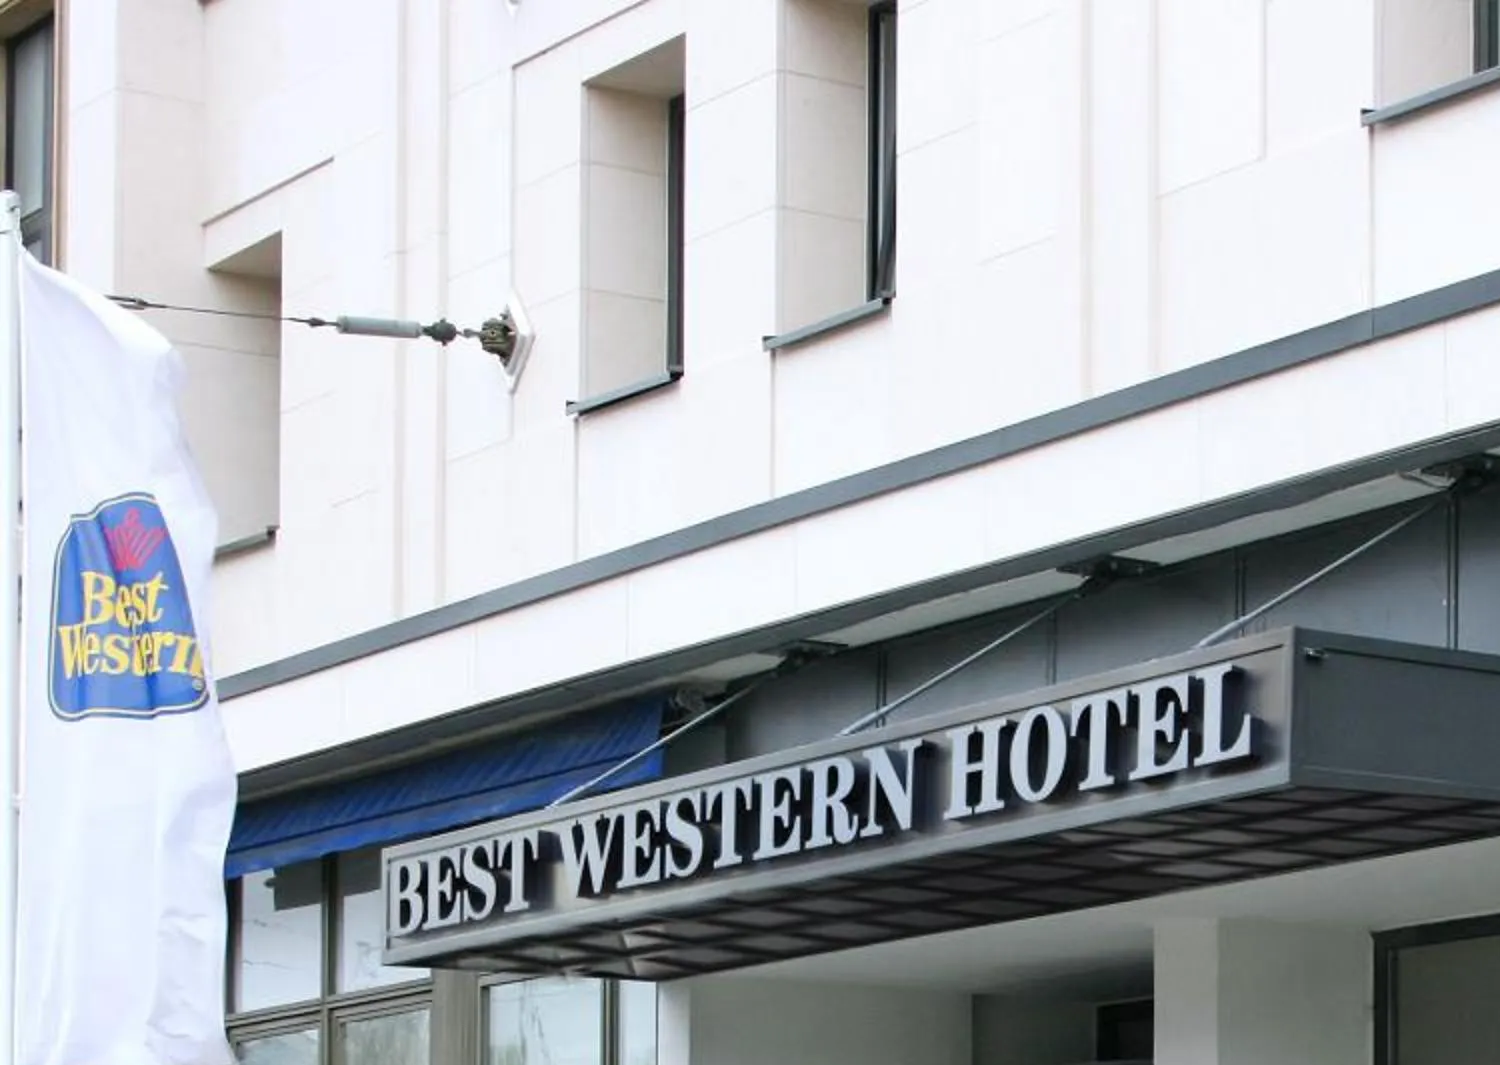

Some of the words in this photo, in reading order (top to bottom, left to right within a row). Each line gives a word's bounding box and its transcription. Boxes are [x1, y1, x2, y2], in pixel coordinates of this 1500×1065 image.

[81, 570, 169, 628] Best
[58, 620, 205, 681] Western
[389, 828, 540, 938] BEST
[557, 738, 925, 900] WESTERN
[943, 663, 1252, 821] HOTEL
